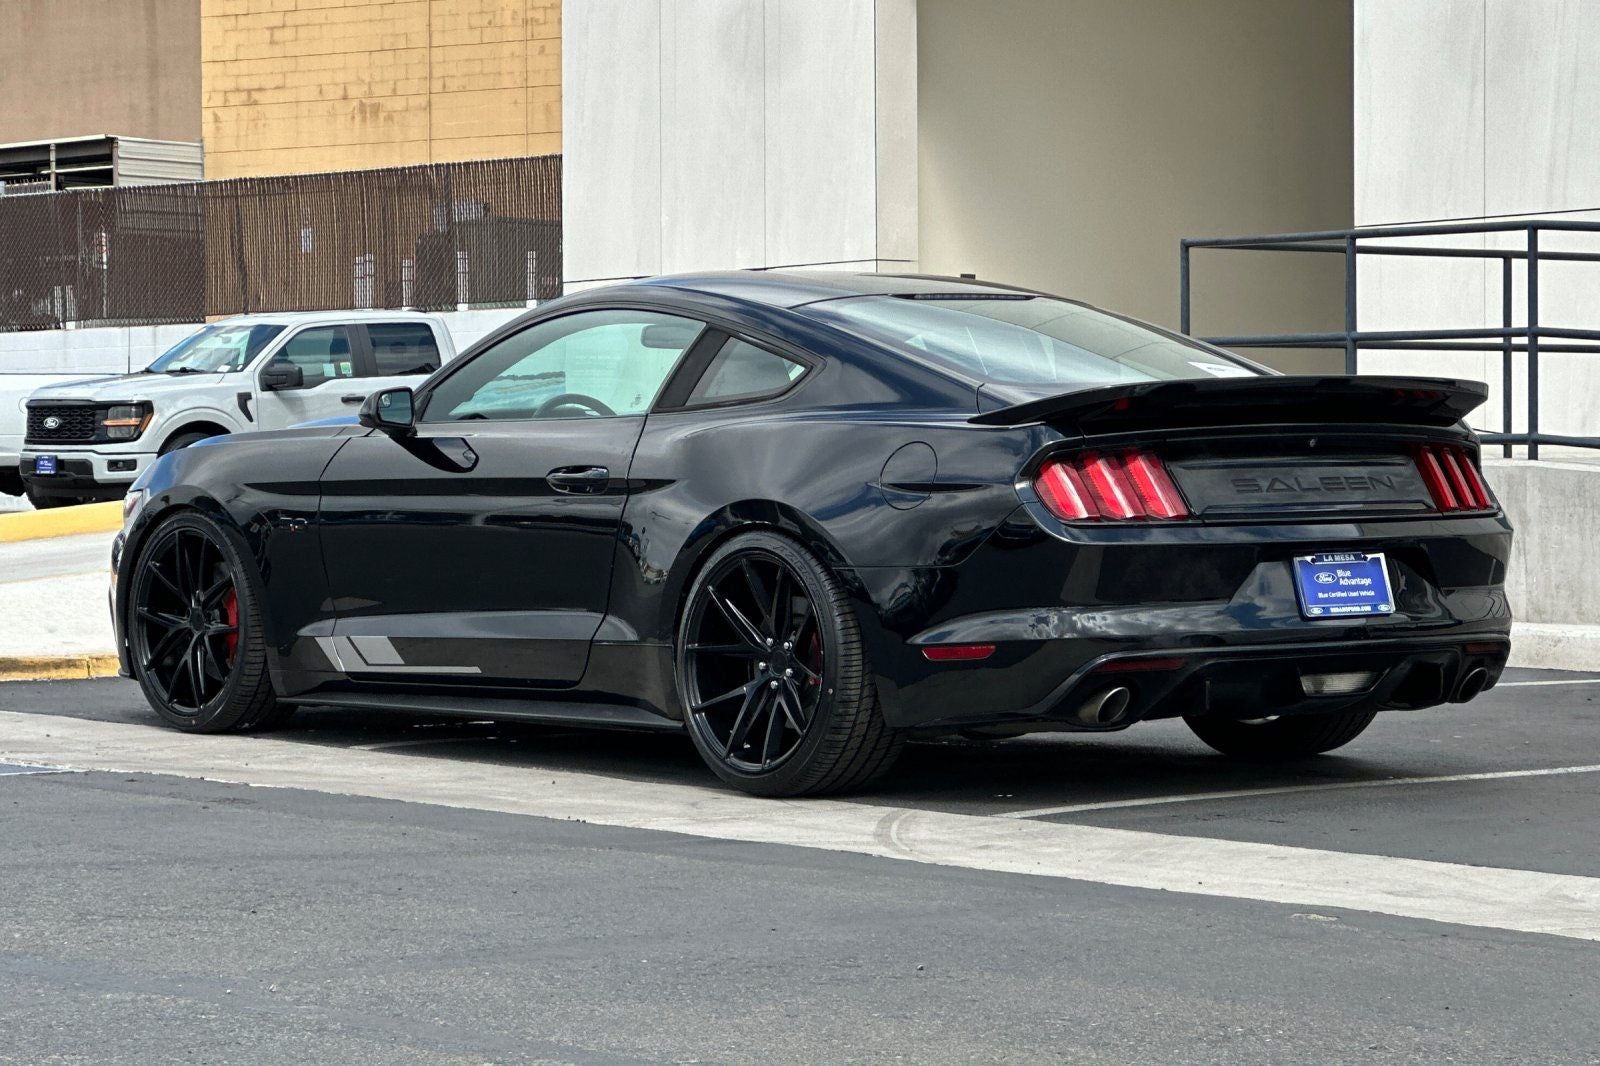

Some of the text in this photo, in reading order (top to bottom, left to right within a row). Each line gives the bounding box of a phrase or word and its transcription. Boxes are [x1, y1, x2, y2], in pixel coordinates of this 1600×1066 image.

[1231, 475, 1398, 494] SALEEN
[1336, 569, 1351, 577] Blue
[1317, 573, 1335, 583] Ford
[1339, 577, 1372, 586] Advantage
